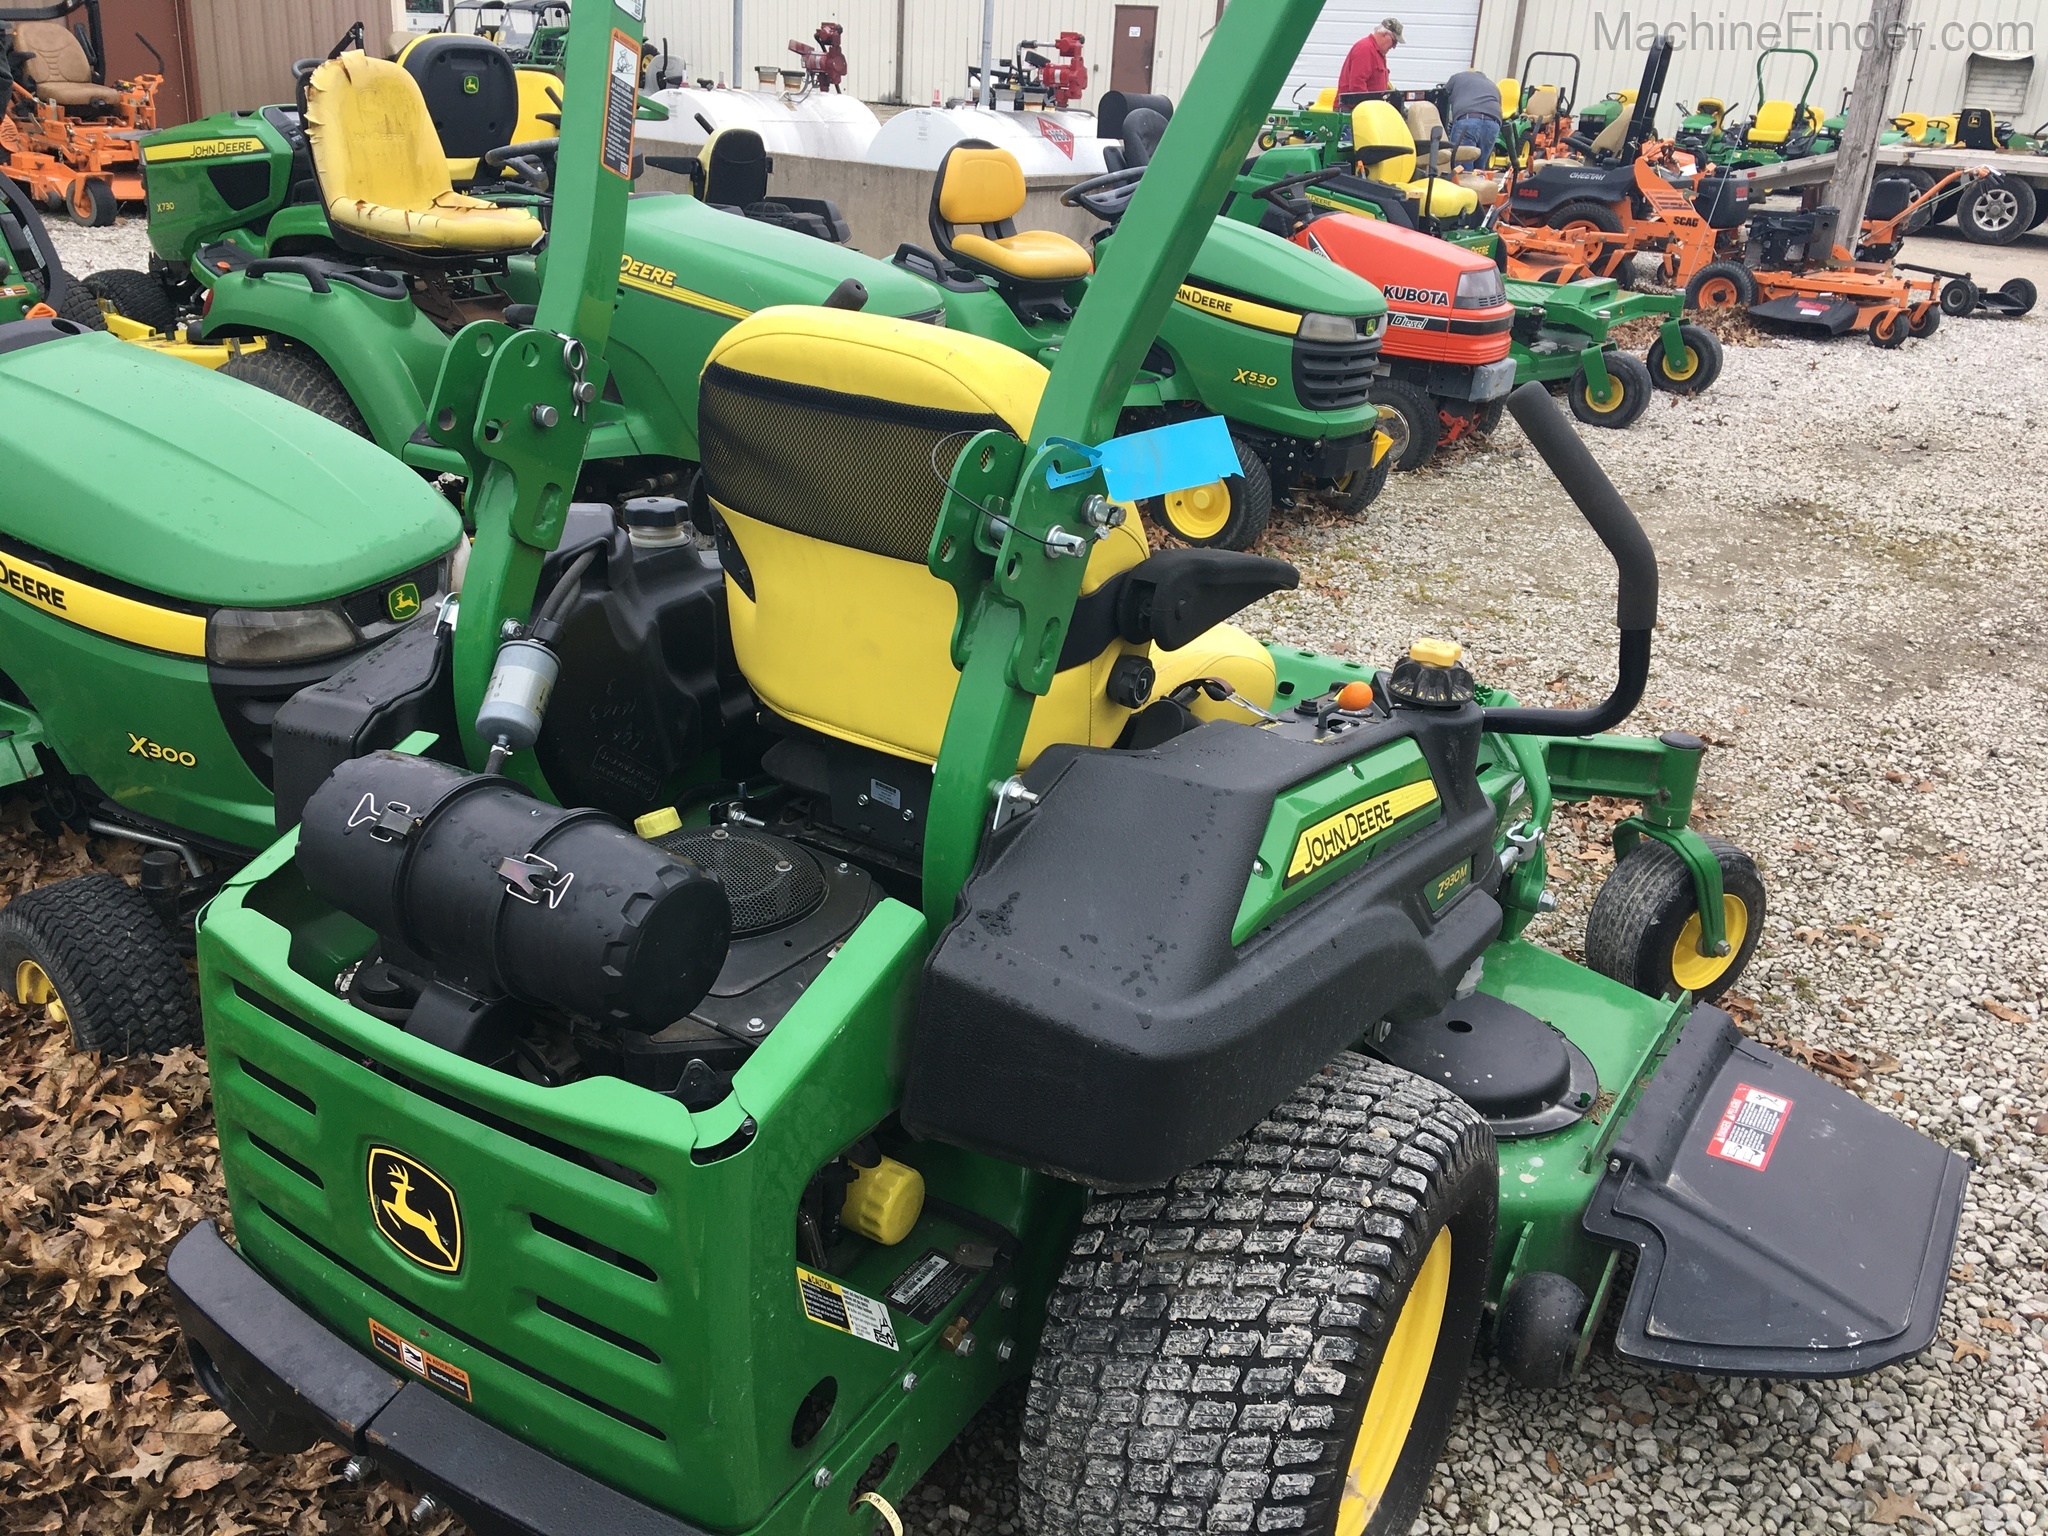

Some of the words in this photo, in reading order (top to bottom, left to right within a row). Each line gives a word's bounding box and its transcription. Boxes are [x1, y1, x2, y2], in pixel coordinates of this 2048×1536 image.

[191, 144, 215, 157] JOHN
[217, 141, 252, 153] DEERE
[1569, 171, 1606, 181] CHEETAH
[156, 201, 175, 213] X730
[1673, 215, 1699, 228] SCAG
[620, 254, 677, 287] DEERE
[1191, 290, 1233, 313] DEERE
[1383, 285, 1449, 306] KUBOTA
[1391, 313, 1429, 330] Diesel
[1232, 368, 1278, 386] X530
[127, 732, 197, 768] X300
[1304, 824, 1345, 868] JOHN
[1345, 800, 1394, 842] DEERE
[1437, 863, 1468, 900] Z930M
[811, 1275, 833, 1292] CAUTION
